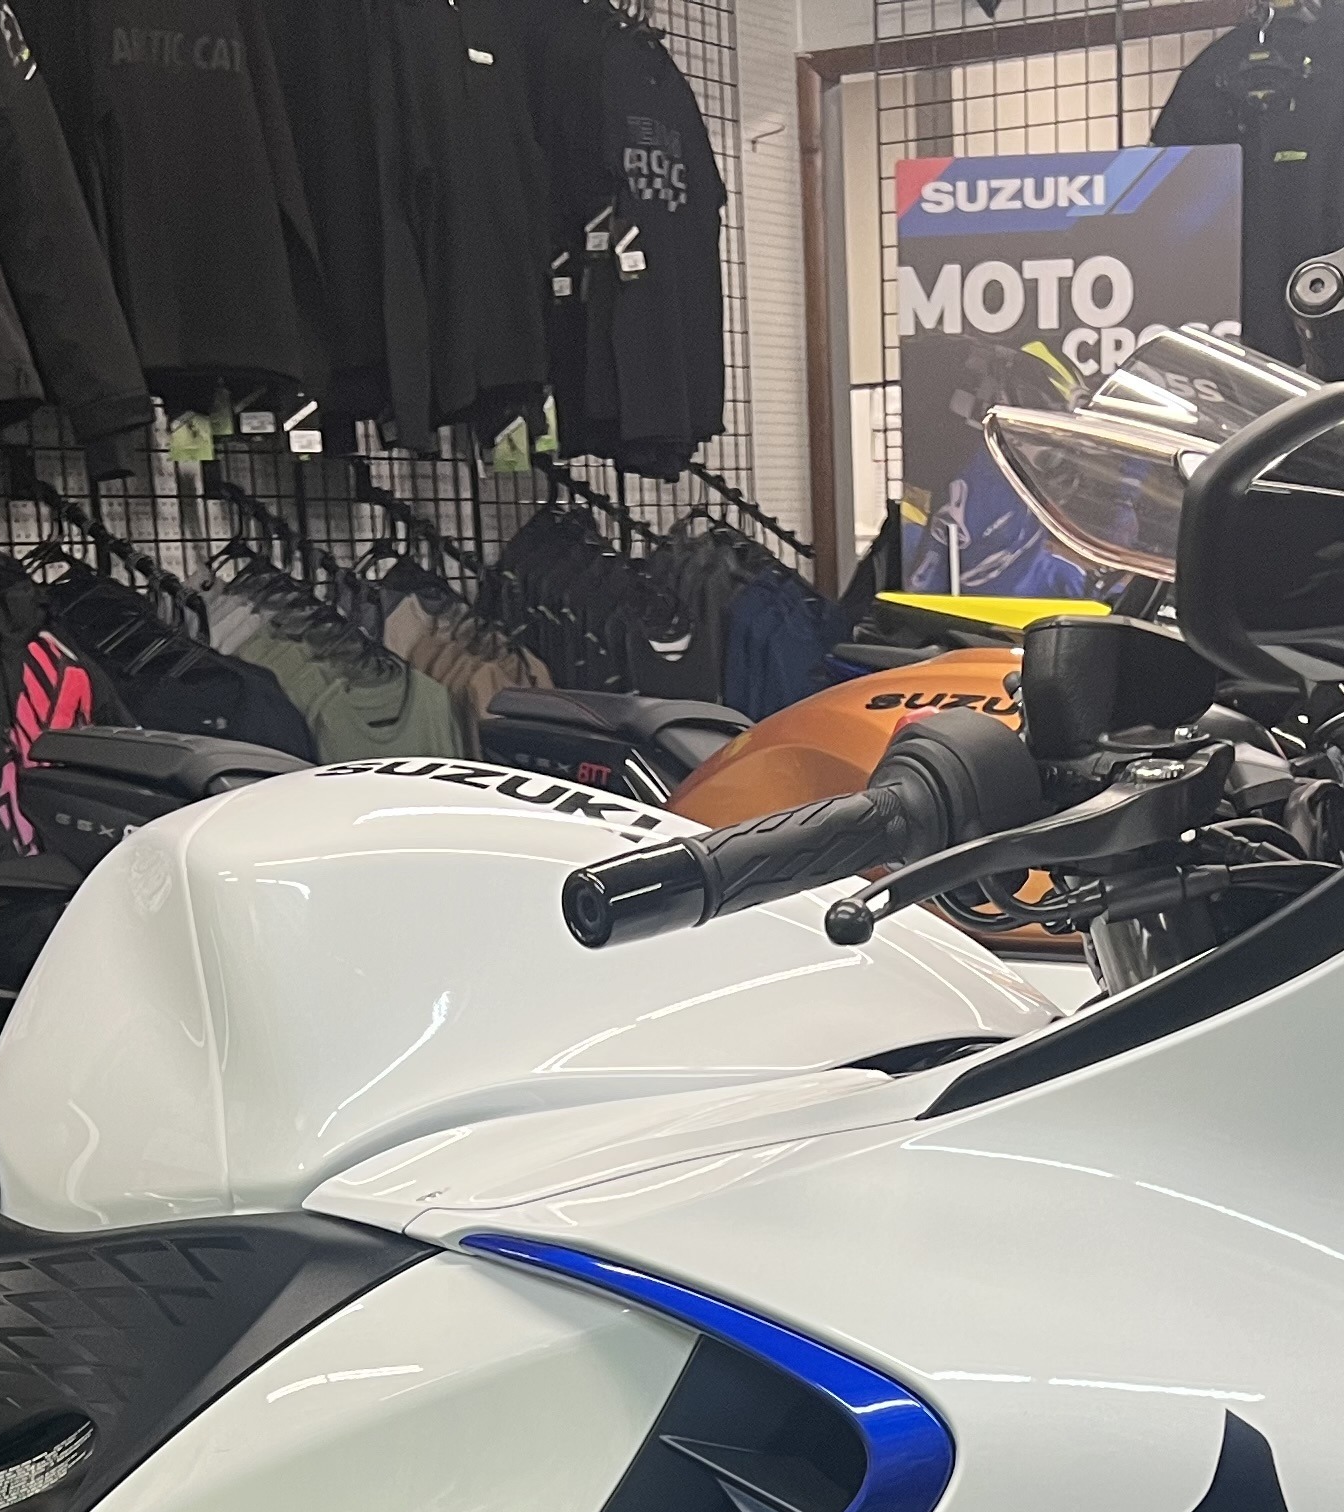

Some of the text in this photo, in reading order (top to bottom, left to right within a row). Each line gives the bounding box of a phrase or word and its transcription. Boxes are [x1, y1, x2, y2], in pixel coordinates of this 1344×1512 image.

[920, 174, 1105, 214] SUZUKI
[897, 255, 1134, 335] MOTO
[315, 761, 662, 844] SUZUKI
